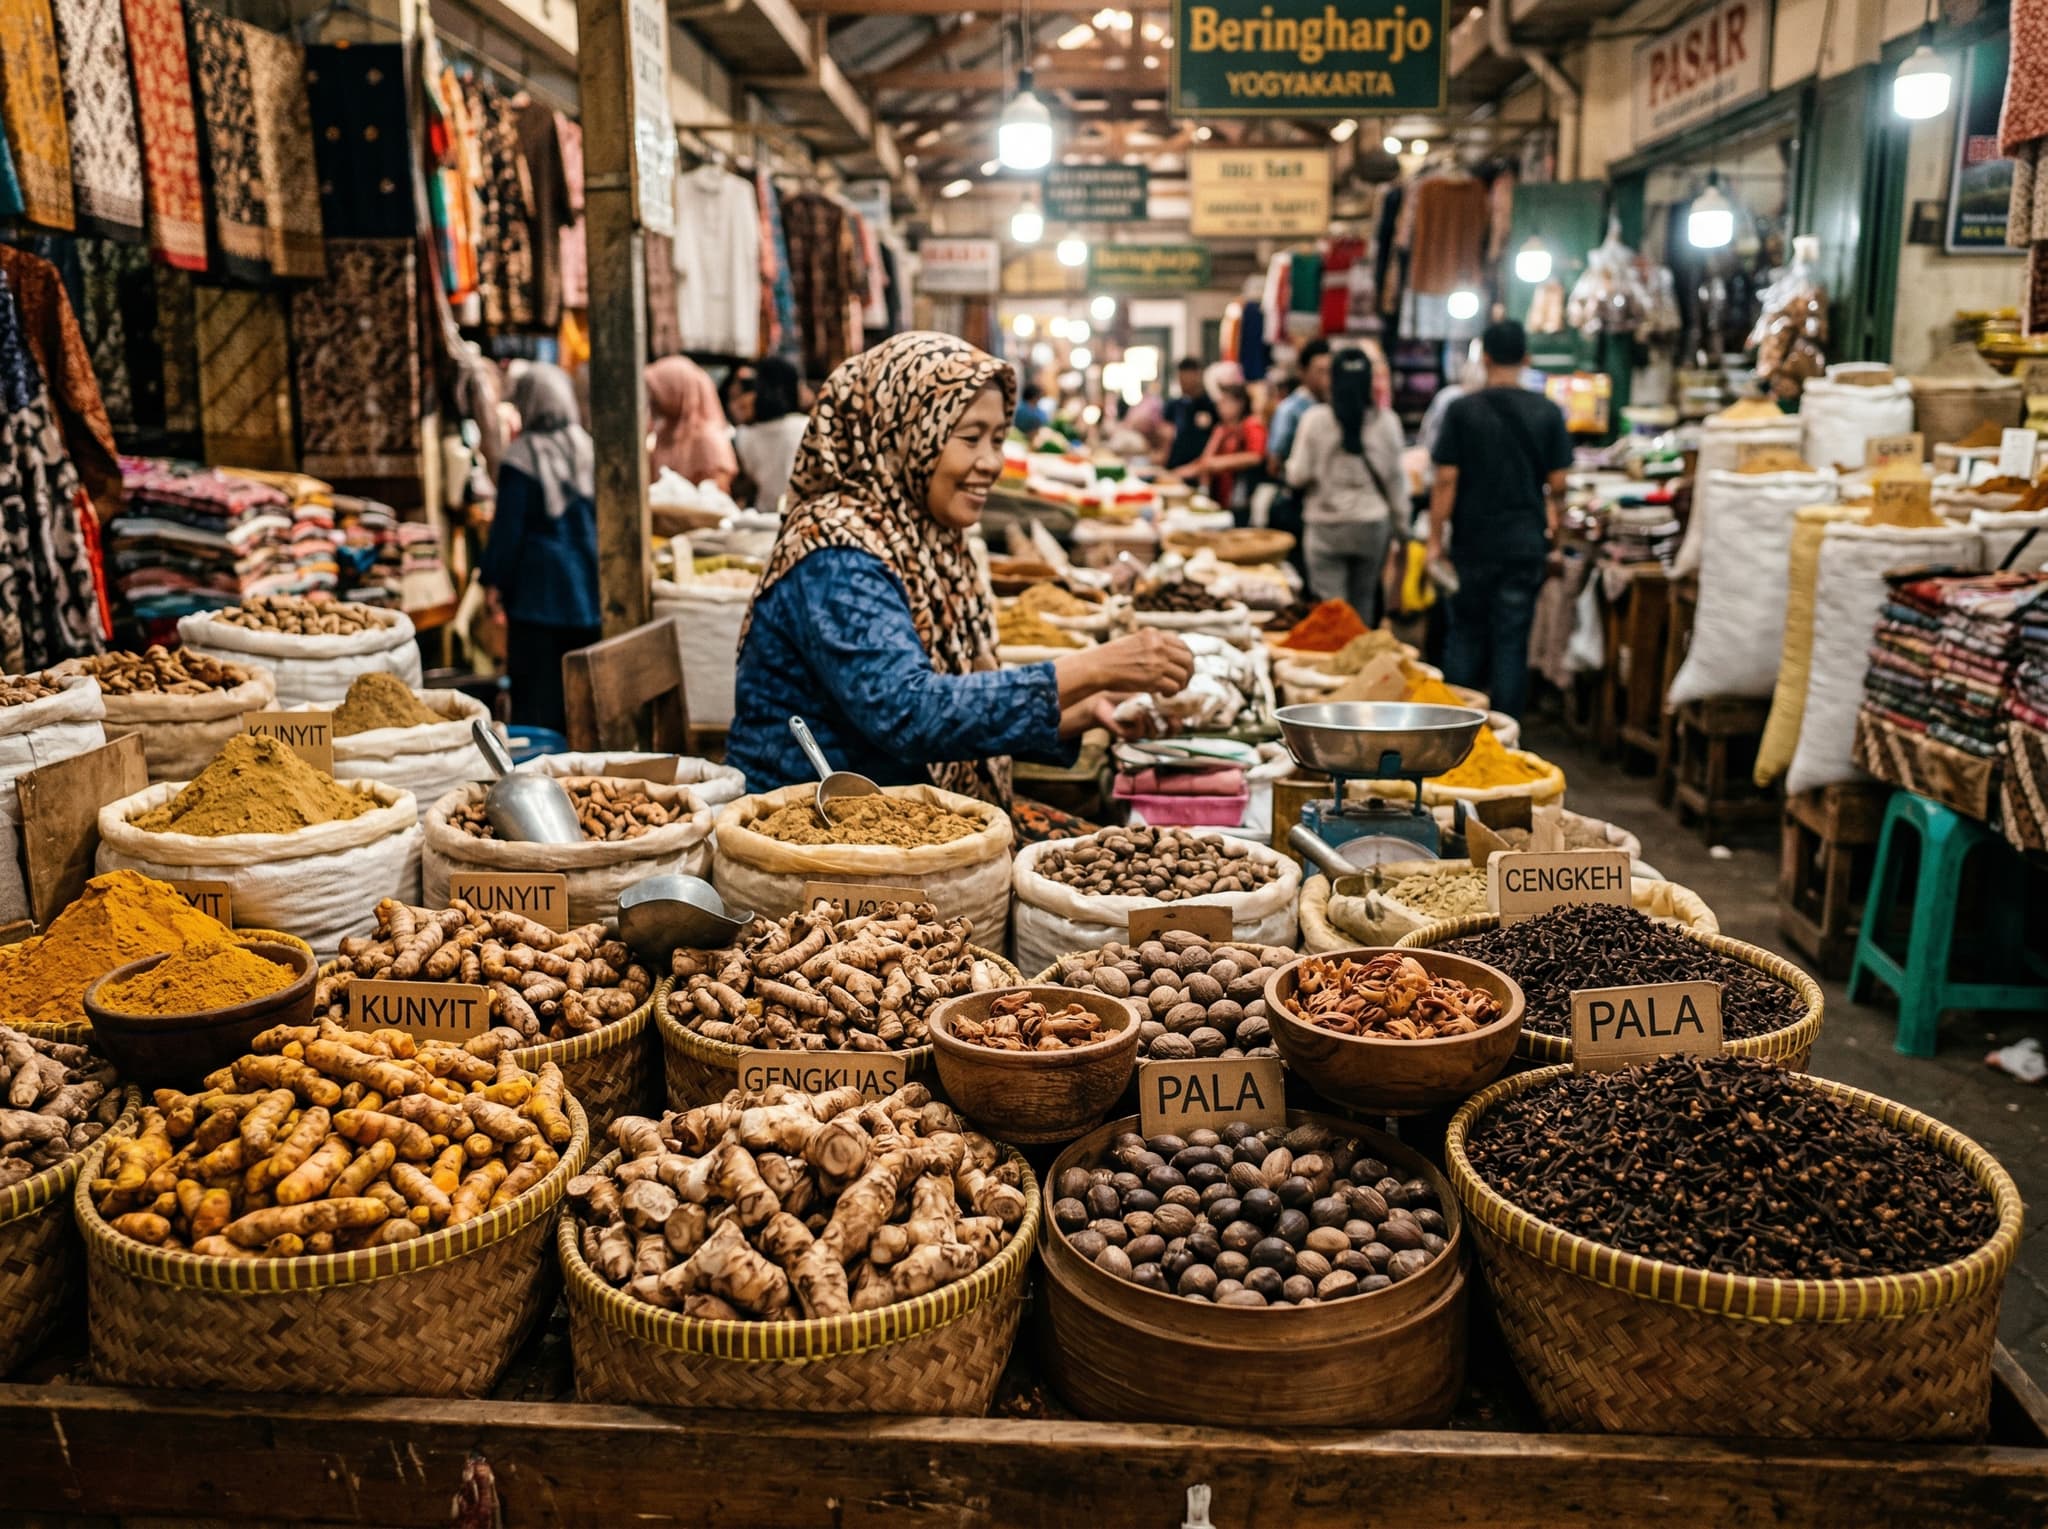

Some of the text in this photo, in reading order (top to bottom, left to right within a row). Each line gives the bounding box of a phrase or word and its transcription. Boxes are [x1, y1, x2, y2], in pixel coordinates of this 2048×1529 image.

[1189, 5, 1433, 64] Beringharjo
[1648, 4, 1748, 108] PASAR
[1225, 71, 1395, 97] YOGYAKARTA
[1505, 866, 1622, 892] CENGKEH
[459, 886, 556, 911] KUNYIT
[362, 995, 478, 1029] KUNYIT
[1588, 994, 1704, 1042] PALA
[1158, 1072, 1265, 1115] PALA
